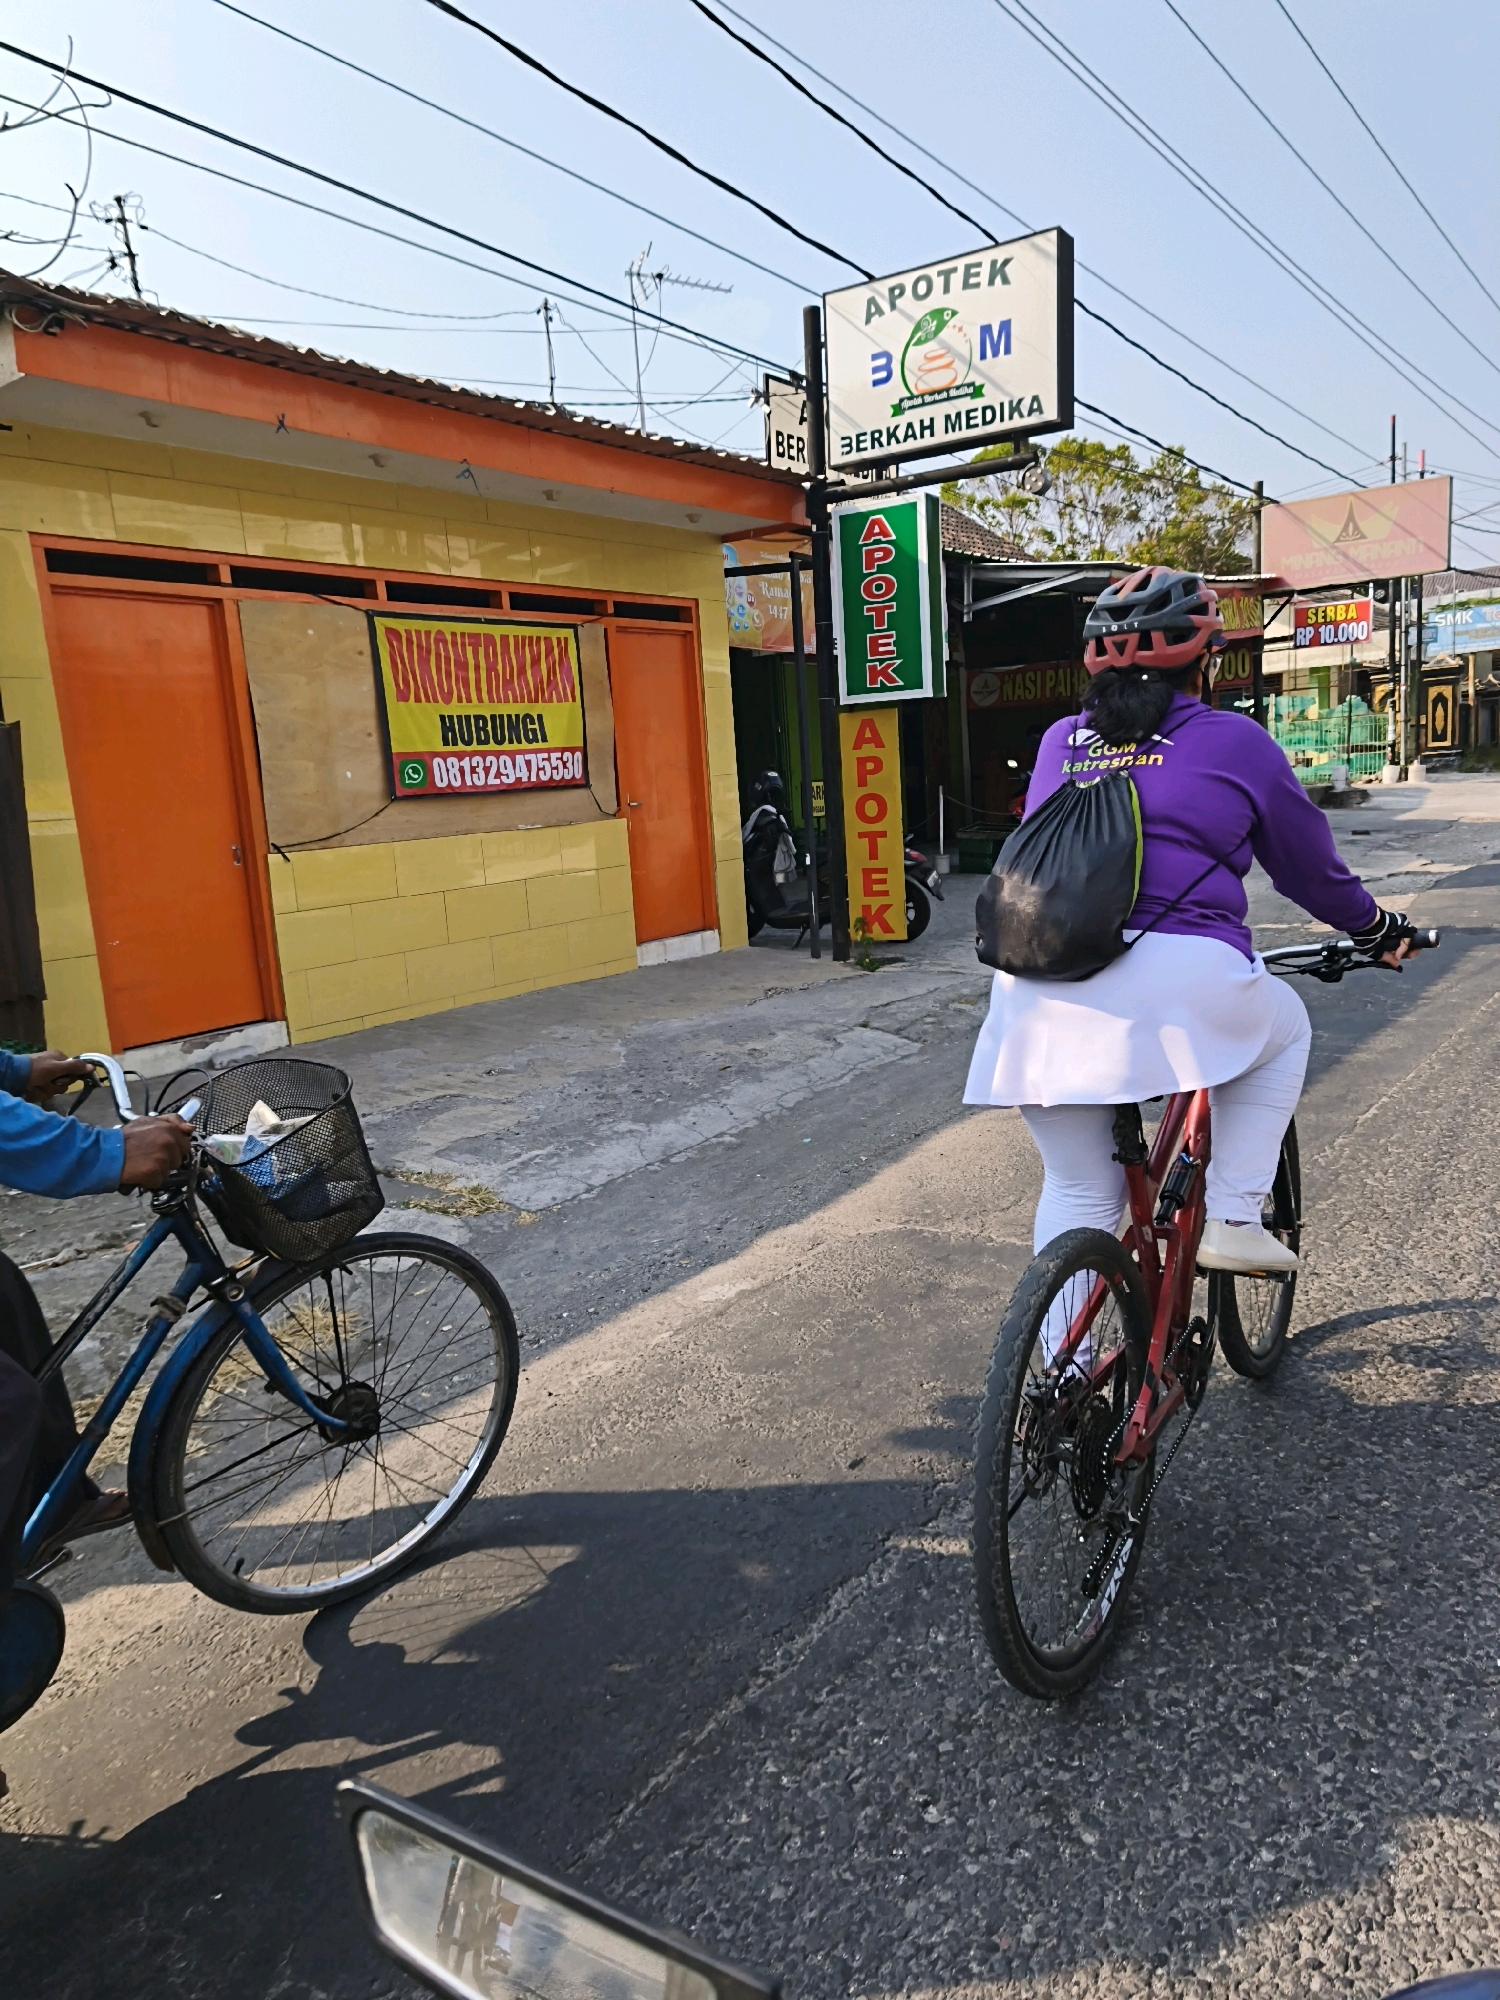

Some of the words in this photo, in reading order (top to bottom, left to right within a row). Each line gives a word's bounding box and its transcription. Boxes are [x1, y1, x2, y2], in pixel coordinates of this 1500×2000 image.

[864, 256, 1015, 326] APOTEK
[979, 318, 1012, 362] M
[841, 418, 935, 456] BERKAH
[944, 394, 1044, 435] MEDIKA
[858, 514, 904, 688] APOTEK
[1307, 603, 1358, 625] SERBA
[1434, 610, 1474, 627] SMK
[1296, 626, 1315, 647] RP
[1318, 620, 1368, 644] 10.000
[385, 627, 577, 706] DIKONTRAKKAN
[1002, 670, 1042, 702] NASI
[439, 713, 548, 747] HUBUNGI
[432, 751, 583, 788] 081329475530
[1061, 754, 1164, 774] katresnan
[852, 717, 895, 935] APOTEK
